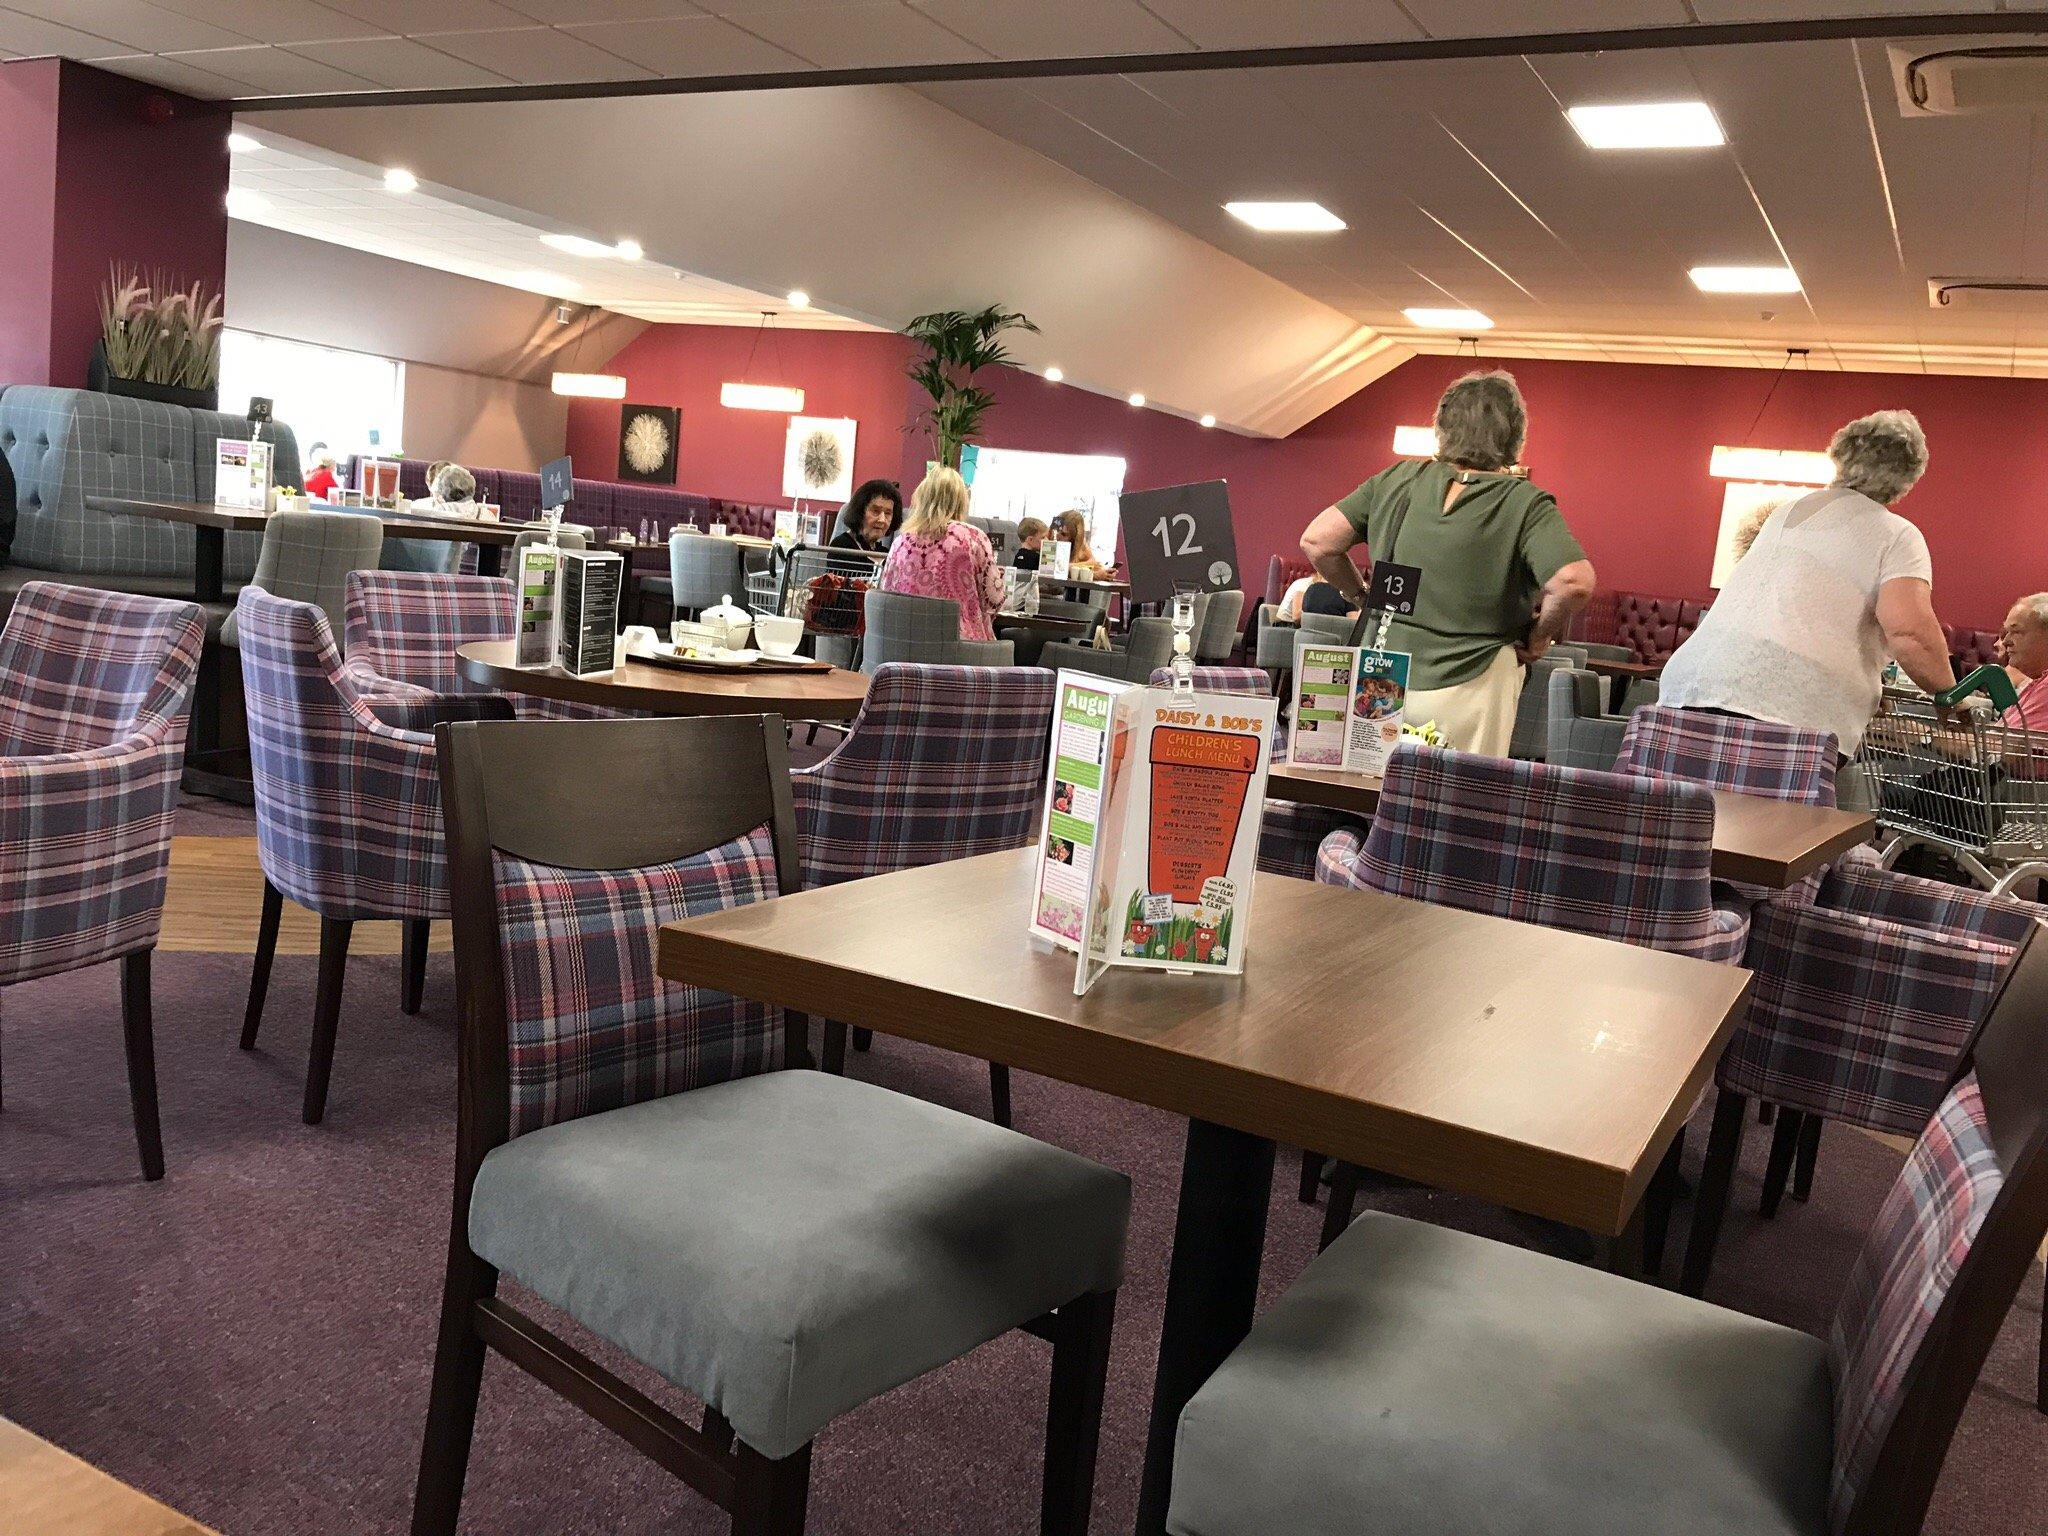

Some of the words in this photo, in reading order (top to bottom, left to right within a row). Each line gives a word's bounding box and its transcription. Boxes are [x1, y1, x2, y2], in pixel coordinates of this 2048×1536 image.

[255, 404, 268, 414] 43
[549, 470, 562, 490] 14
[1151, 513, 1203, 557] 12
[527, 554, 556, 566] August
[1384, 575, 1404, 595] 13
[1307, 651, 1350, 663] August
[1363, 655, 1393, 673] grow
[1066, 689, 1108, 717] Augu
[1155, 708, 1201, 725] DAISY
[1205, 714, 1216, 728] &
[1221, 715, 1262, 732] BOB'S
[1168, 733, 1242, 751] CHILDREN'S
[1166, 747, 1203, 760] LUNCH
[1208, 751, 1240, 764] MENU
